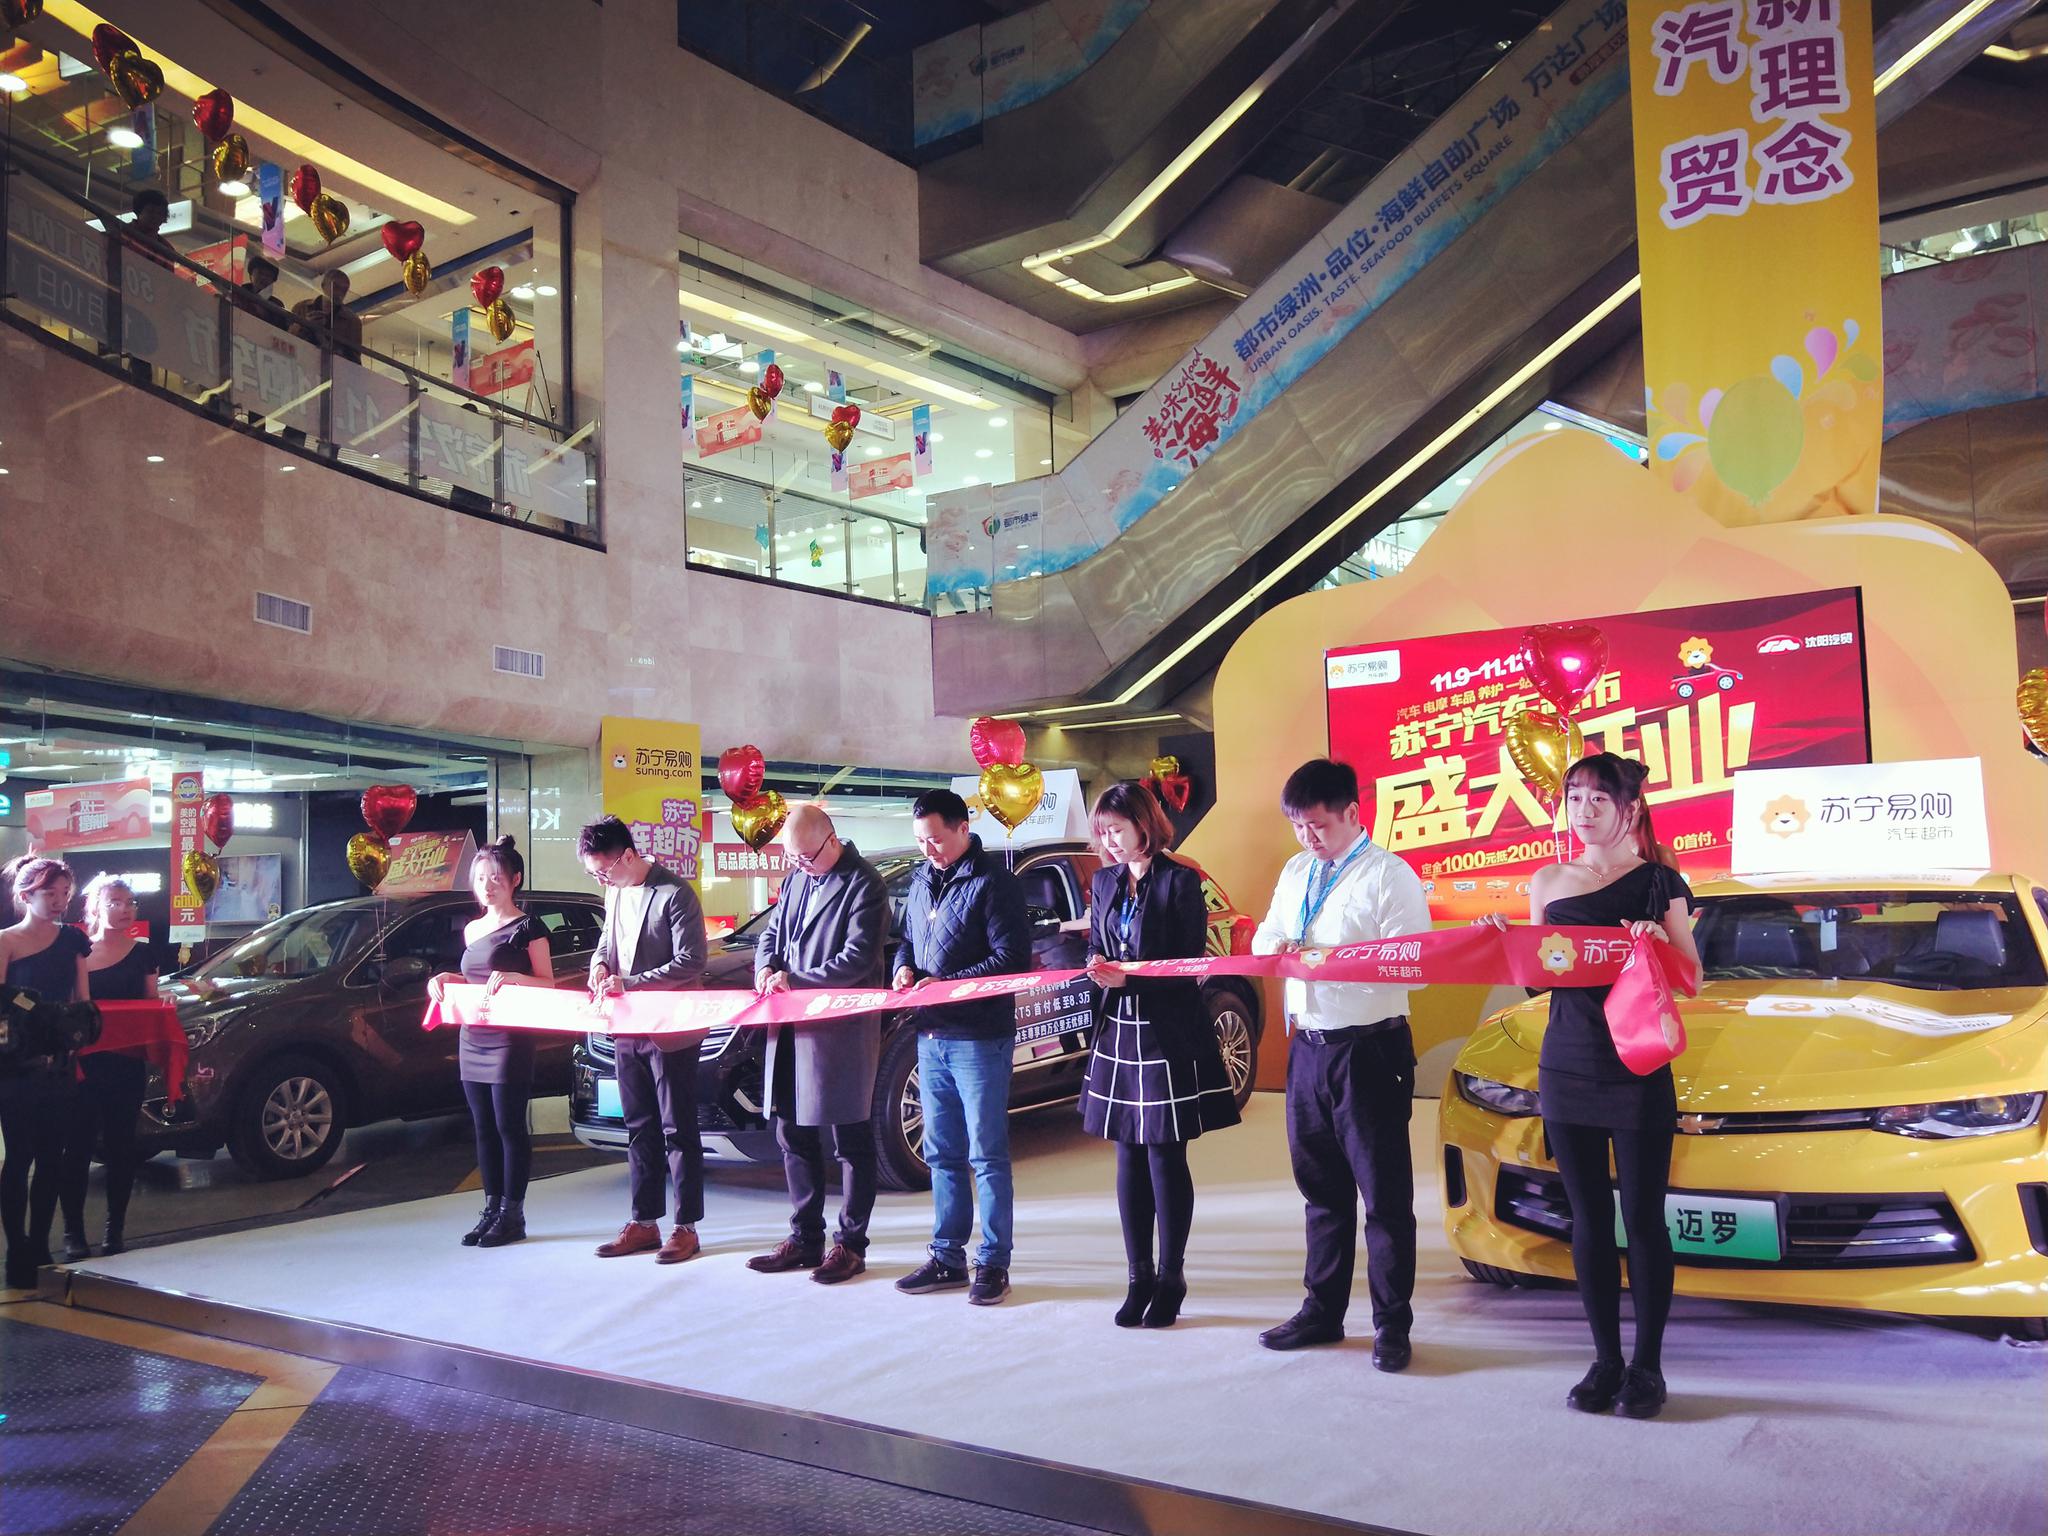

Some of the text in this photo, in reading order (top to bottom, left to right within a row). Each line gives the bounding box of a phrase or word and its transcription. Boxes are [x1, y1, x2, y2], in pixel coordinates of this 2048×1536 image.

[1249, 336, 1289, 374] URBAN
[1360, 223, 1414, 275] SEAFOOD
[1413, 178, 1463, 228] BUFFETS
[1463, 133, 1514, 183] SQUARE
[1396, 704, 1421, 722] 汽车
[1423, 696, 1449, 714] 电摩
[1450, 689, 1476, 708] 车品
[1477, 681, 1504, 700] 养护
[1389, 671, 1622, 761] 苏宁汽车市
[635, 748, 692, 769] 苏宁易购
[635, 767, 693, 779] suning.com
[663, 800, 696, 823] 苏宁
[1820, 792, 1953, 824] 苏宁易购
[1887, 826, 1954, 841] 汽车超市
[717, 850, 769, 871] 高品质家电
[180, 909, 195, 922] 元
[1377, 965, 1423, 977] 汽车超市
